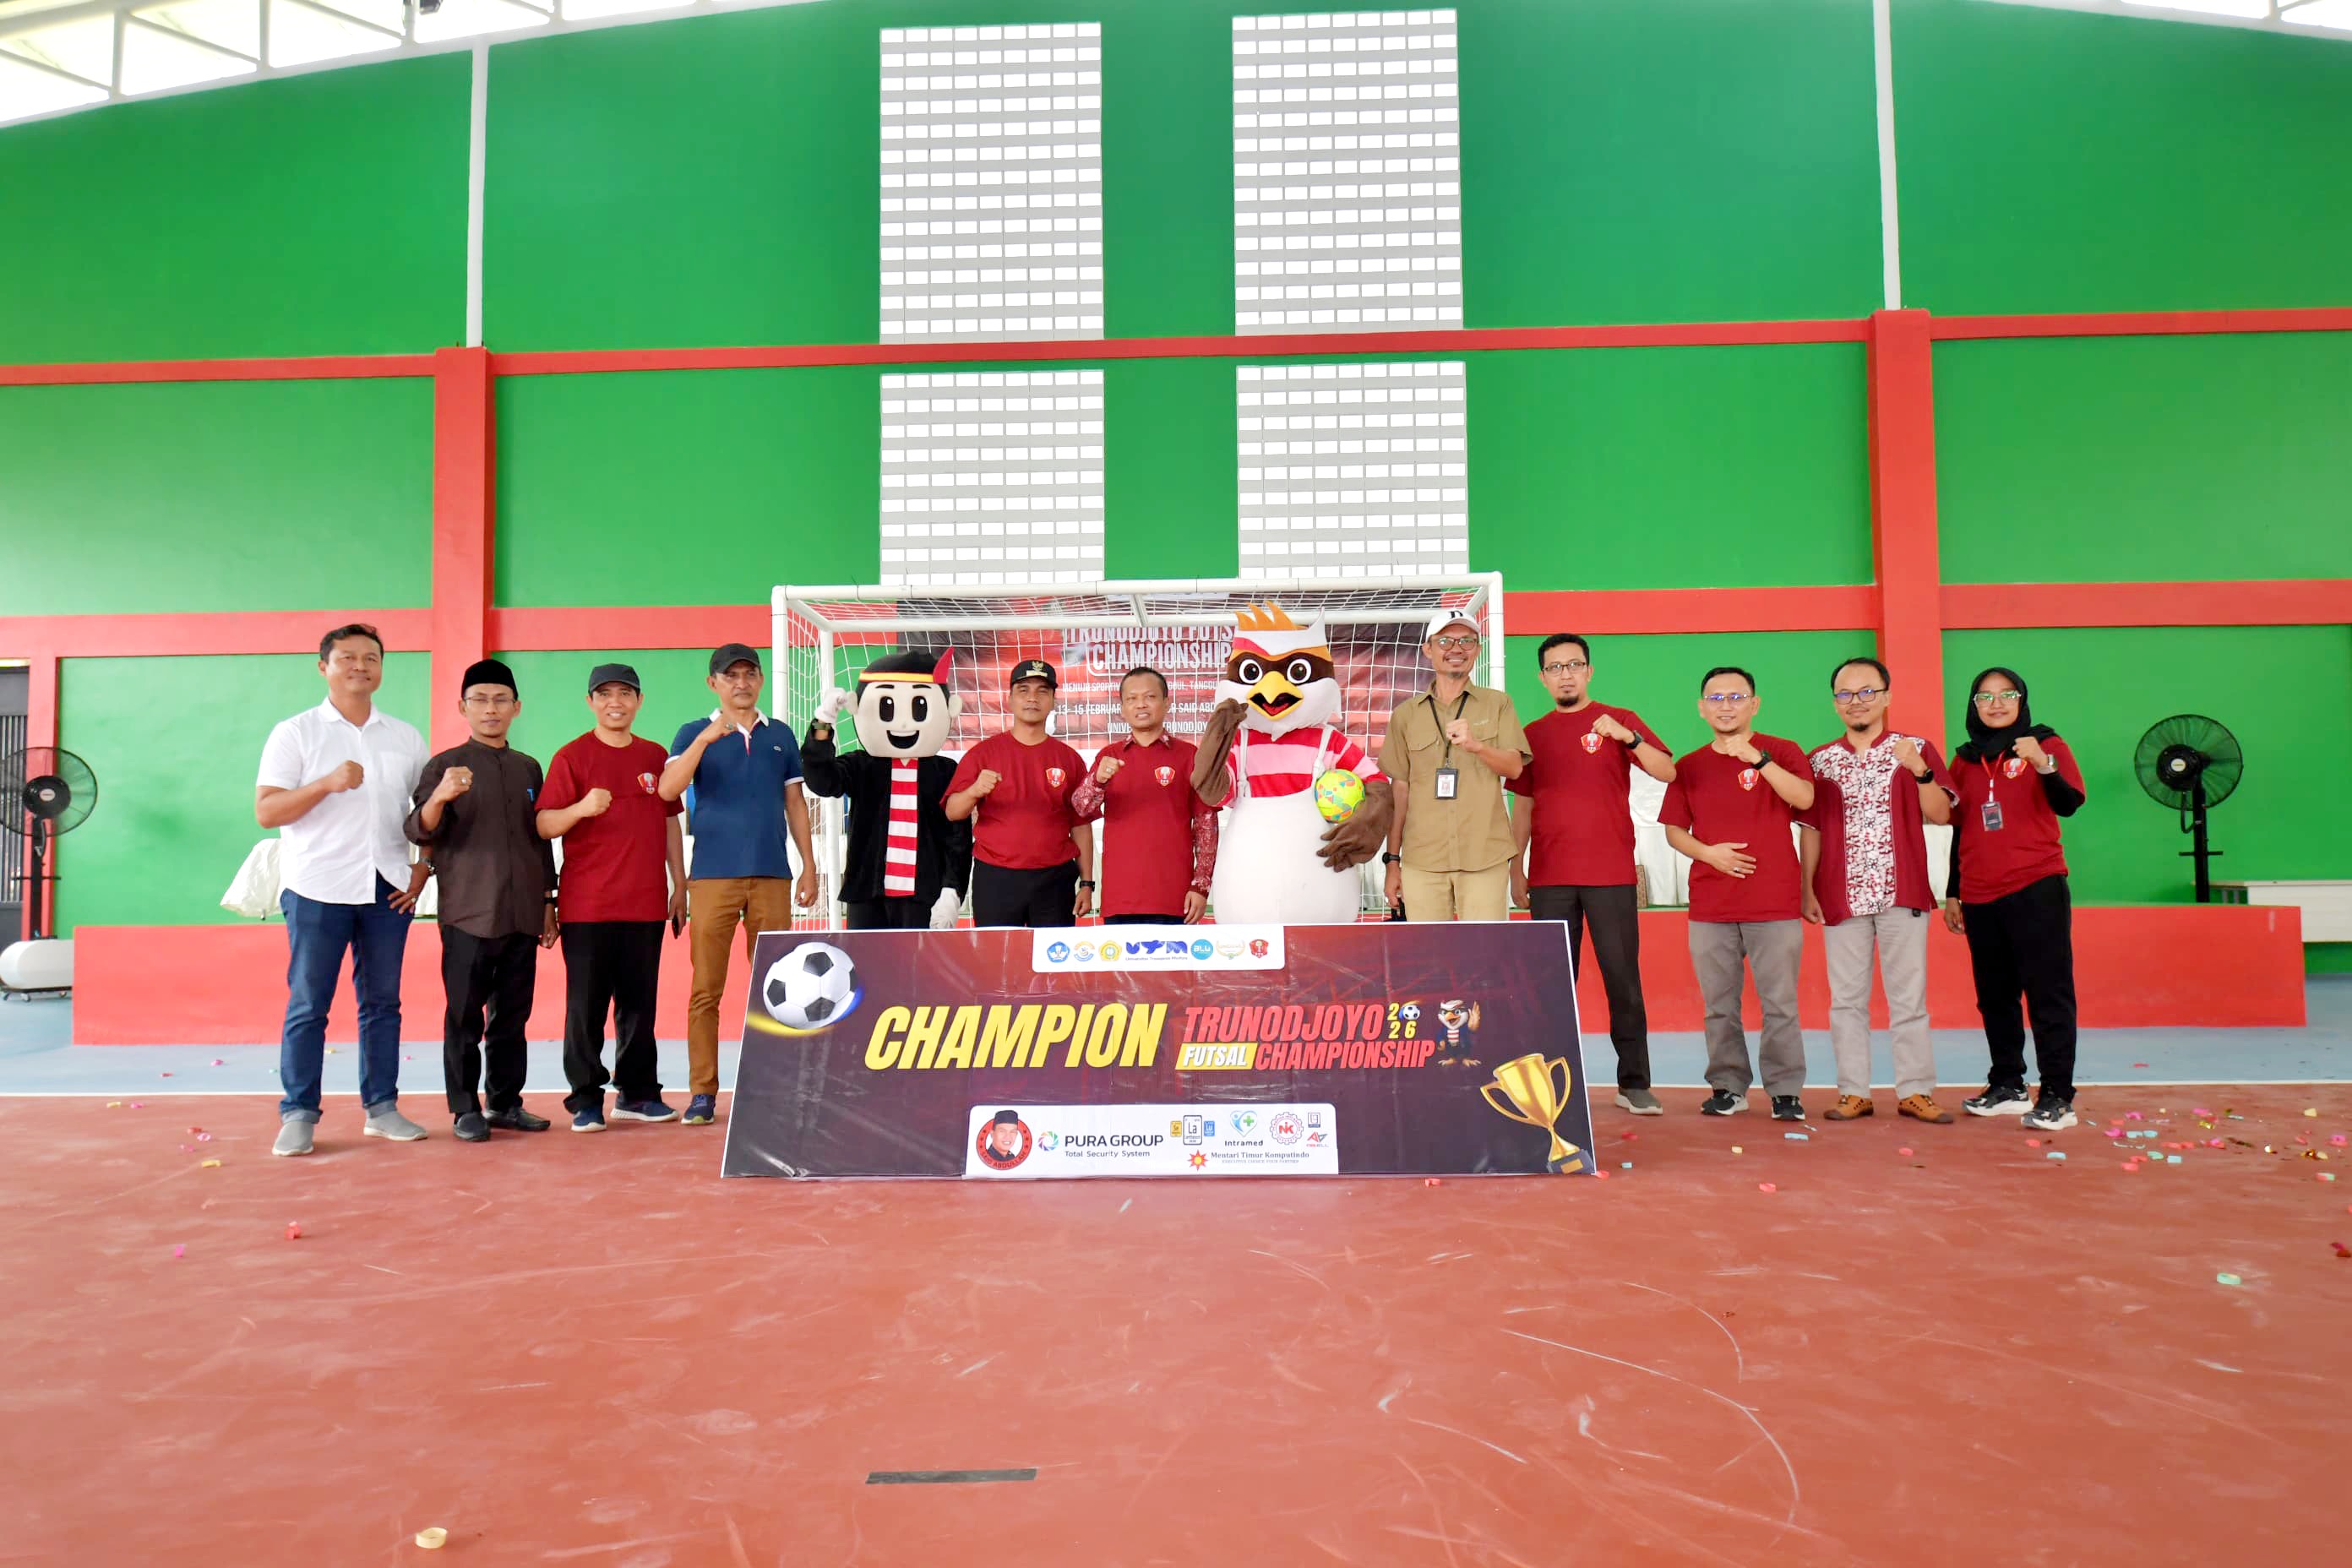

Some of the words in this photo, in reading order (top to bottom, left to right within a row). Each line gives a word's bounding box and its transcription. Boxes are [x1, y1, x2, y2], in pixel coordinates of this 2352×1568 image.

[1190, 626, 1233, 642] FUTS
[1092, 642, 1232, 671] CHAMPIONSHIP
[1189, 680, 1217, 690] TANGGU
[1086, 703, 1122, 715] FEBRUAR
[1178, 702, 1197, 713] SAID
[1162, 721, 1208, 732] TRUNODJOY
[1183, 1004, 1385, 1043] TRUNODJOYO
[864, 1003, 1168, 1070] CHAMPION
[1183, 1046, 1247, 1067] FUTSAL
[1255, 1040, 1437, 1070] CHAMPIONSHIP
[1064, 1135, 1108, 1147] PURA
[1110, 1135, 1164, 1146] GROUP
[1086, 1150, 1119, 1158] Security
[1122, 1150, 1151, 1158] System
[1265, 1152, 1309, 1160] Komputindo
